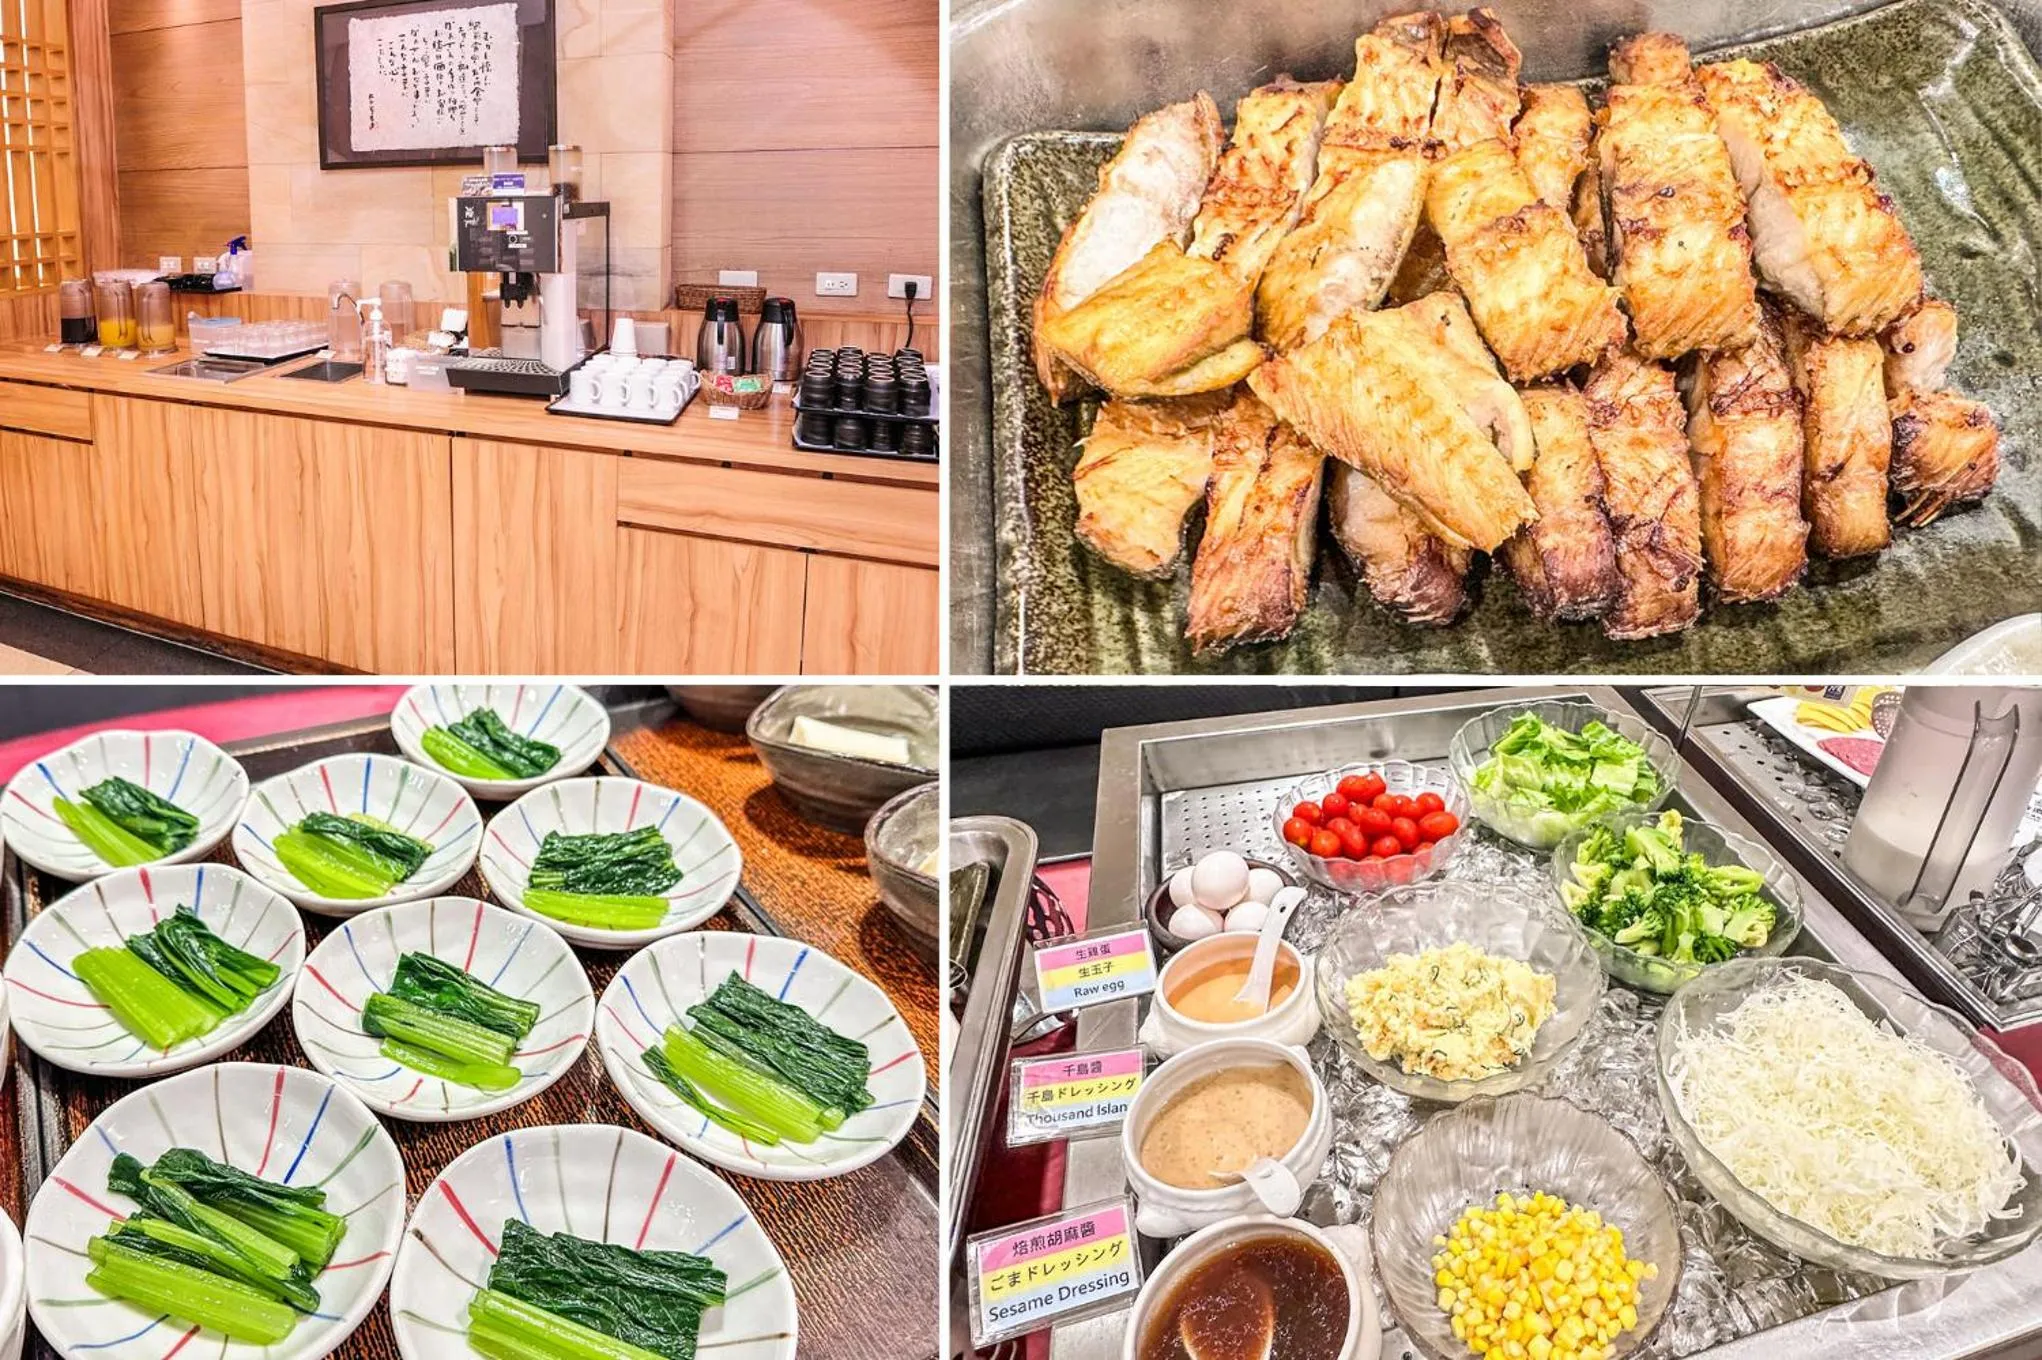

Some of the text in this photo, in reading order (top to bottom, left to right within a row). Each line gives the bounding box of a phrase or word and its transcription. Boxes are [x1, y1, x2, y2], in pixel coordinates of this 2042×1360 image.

[1078, 961, 1114, 979] 生玉子
[1073, 980, 1125, 998] Raw egg
[1027, 1102, 1128, 1125] Thousand Islan
[991, 1240, 1124, 1292] ごまドレッシング
[989, 1271, 1130, 1323] Sesame Dressing
